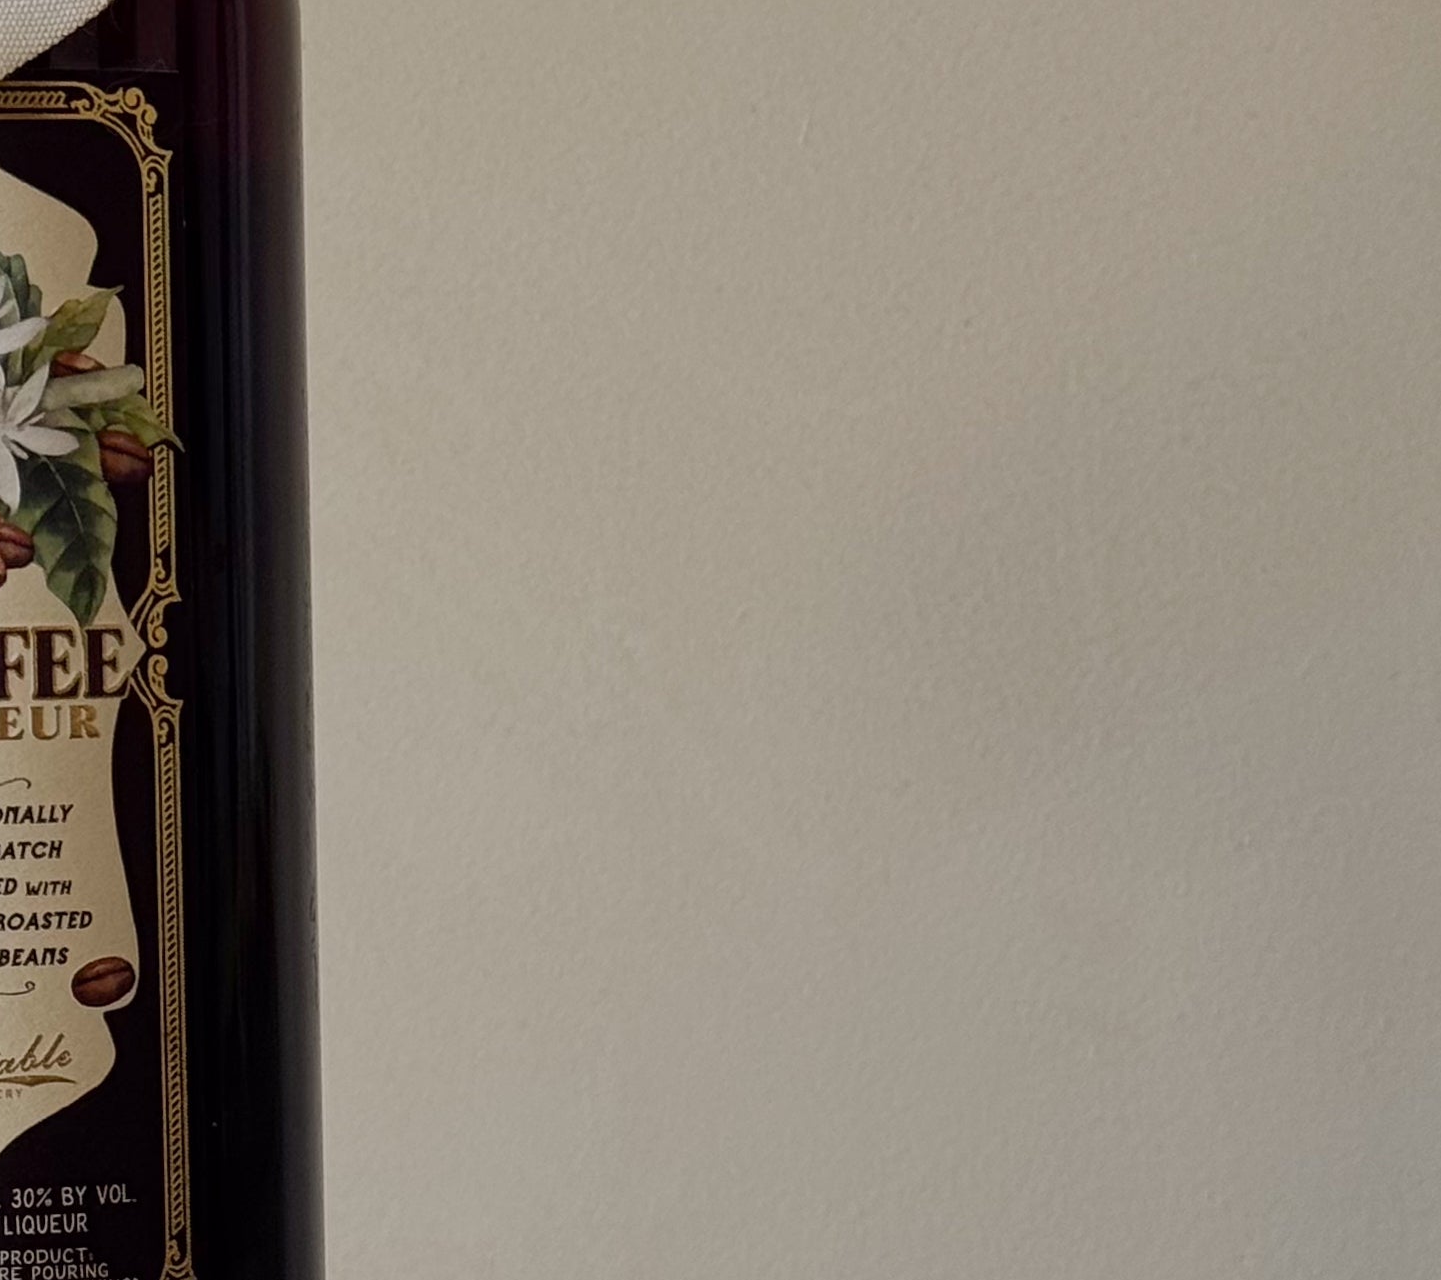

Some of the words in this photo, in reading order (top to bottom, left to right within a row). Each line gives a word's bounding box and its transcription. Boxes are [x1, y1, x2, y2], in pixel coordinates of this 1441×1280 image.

[25, 880, 72, 896] WITH
[11, 1187, 53, 1208] 30%
[61, 1184, 87, 1206] BY
[95, 1183, 137, 1205] VOL.
[3, 1212, 88, 1235] LIQUEUR
[31, 1262, 109, 1280] POURING
